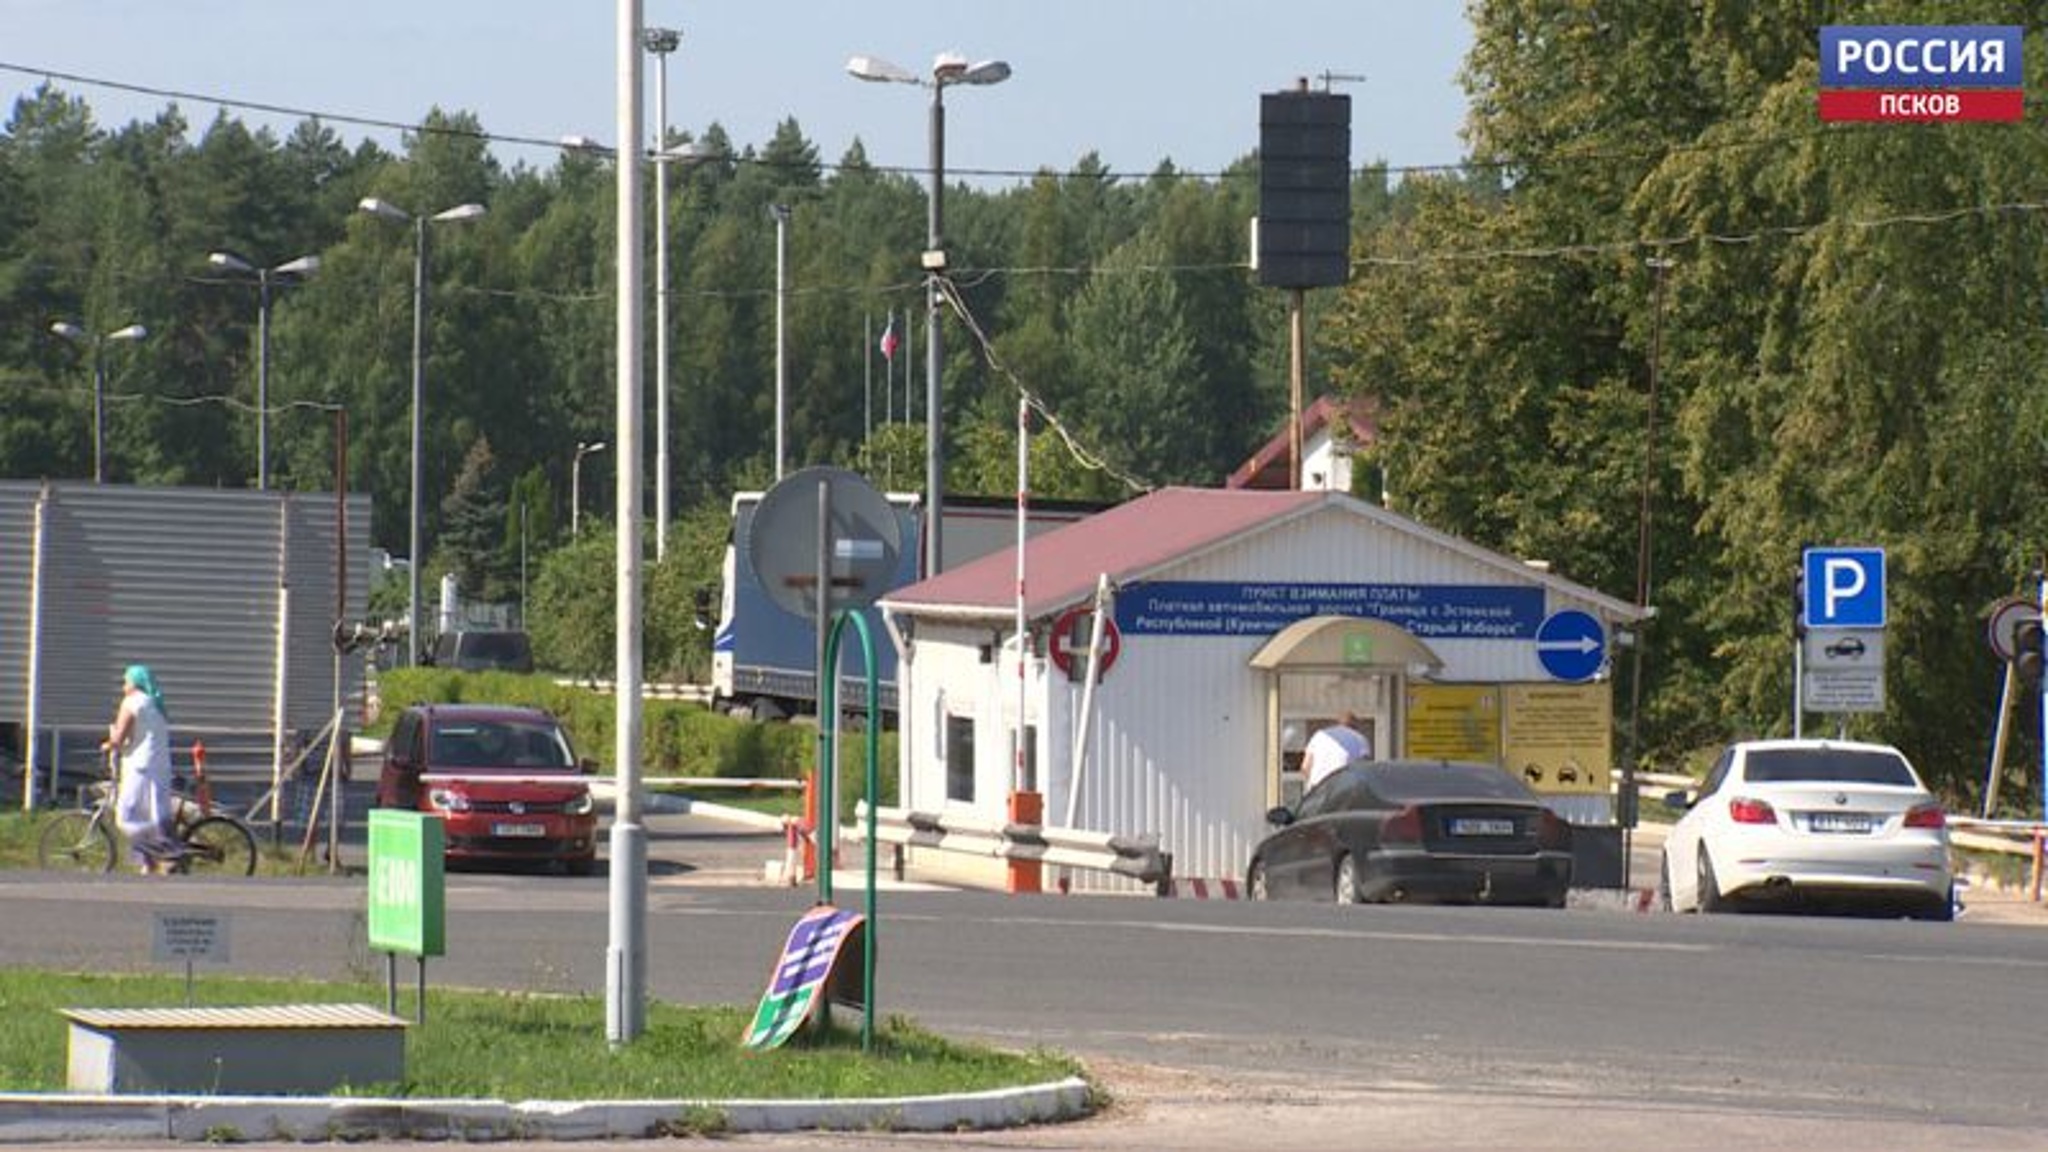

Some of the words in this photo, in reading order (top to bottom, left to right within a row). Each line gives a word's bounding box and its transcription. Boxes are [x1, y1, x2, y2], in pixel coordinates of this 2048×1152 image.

[1242, 586, 1285, 600] ПУНКТ
[1289, 587, 1368, 601] ВЗИМАНИЯ
[1371, 587, 1420, 601] ПЛАТЫ
[1824, 558, 1866, 618] P
[1148, 598, 1205, 613] Платная
[1208, 599, 1311, 615] автомобильная
[1442, 602, 1512, 618] Эстонской
[1136, 615, 1223, 631] Республикой
[1405, 619, 1458, 635] Старый
